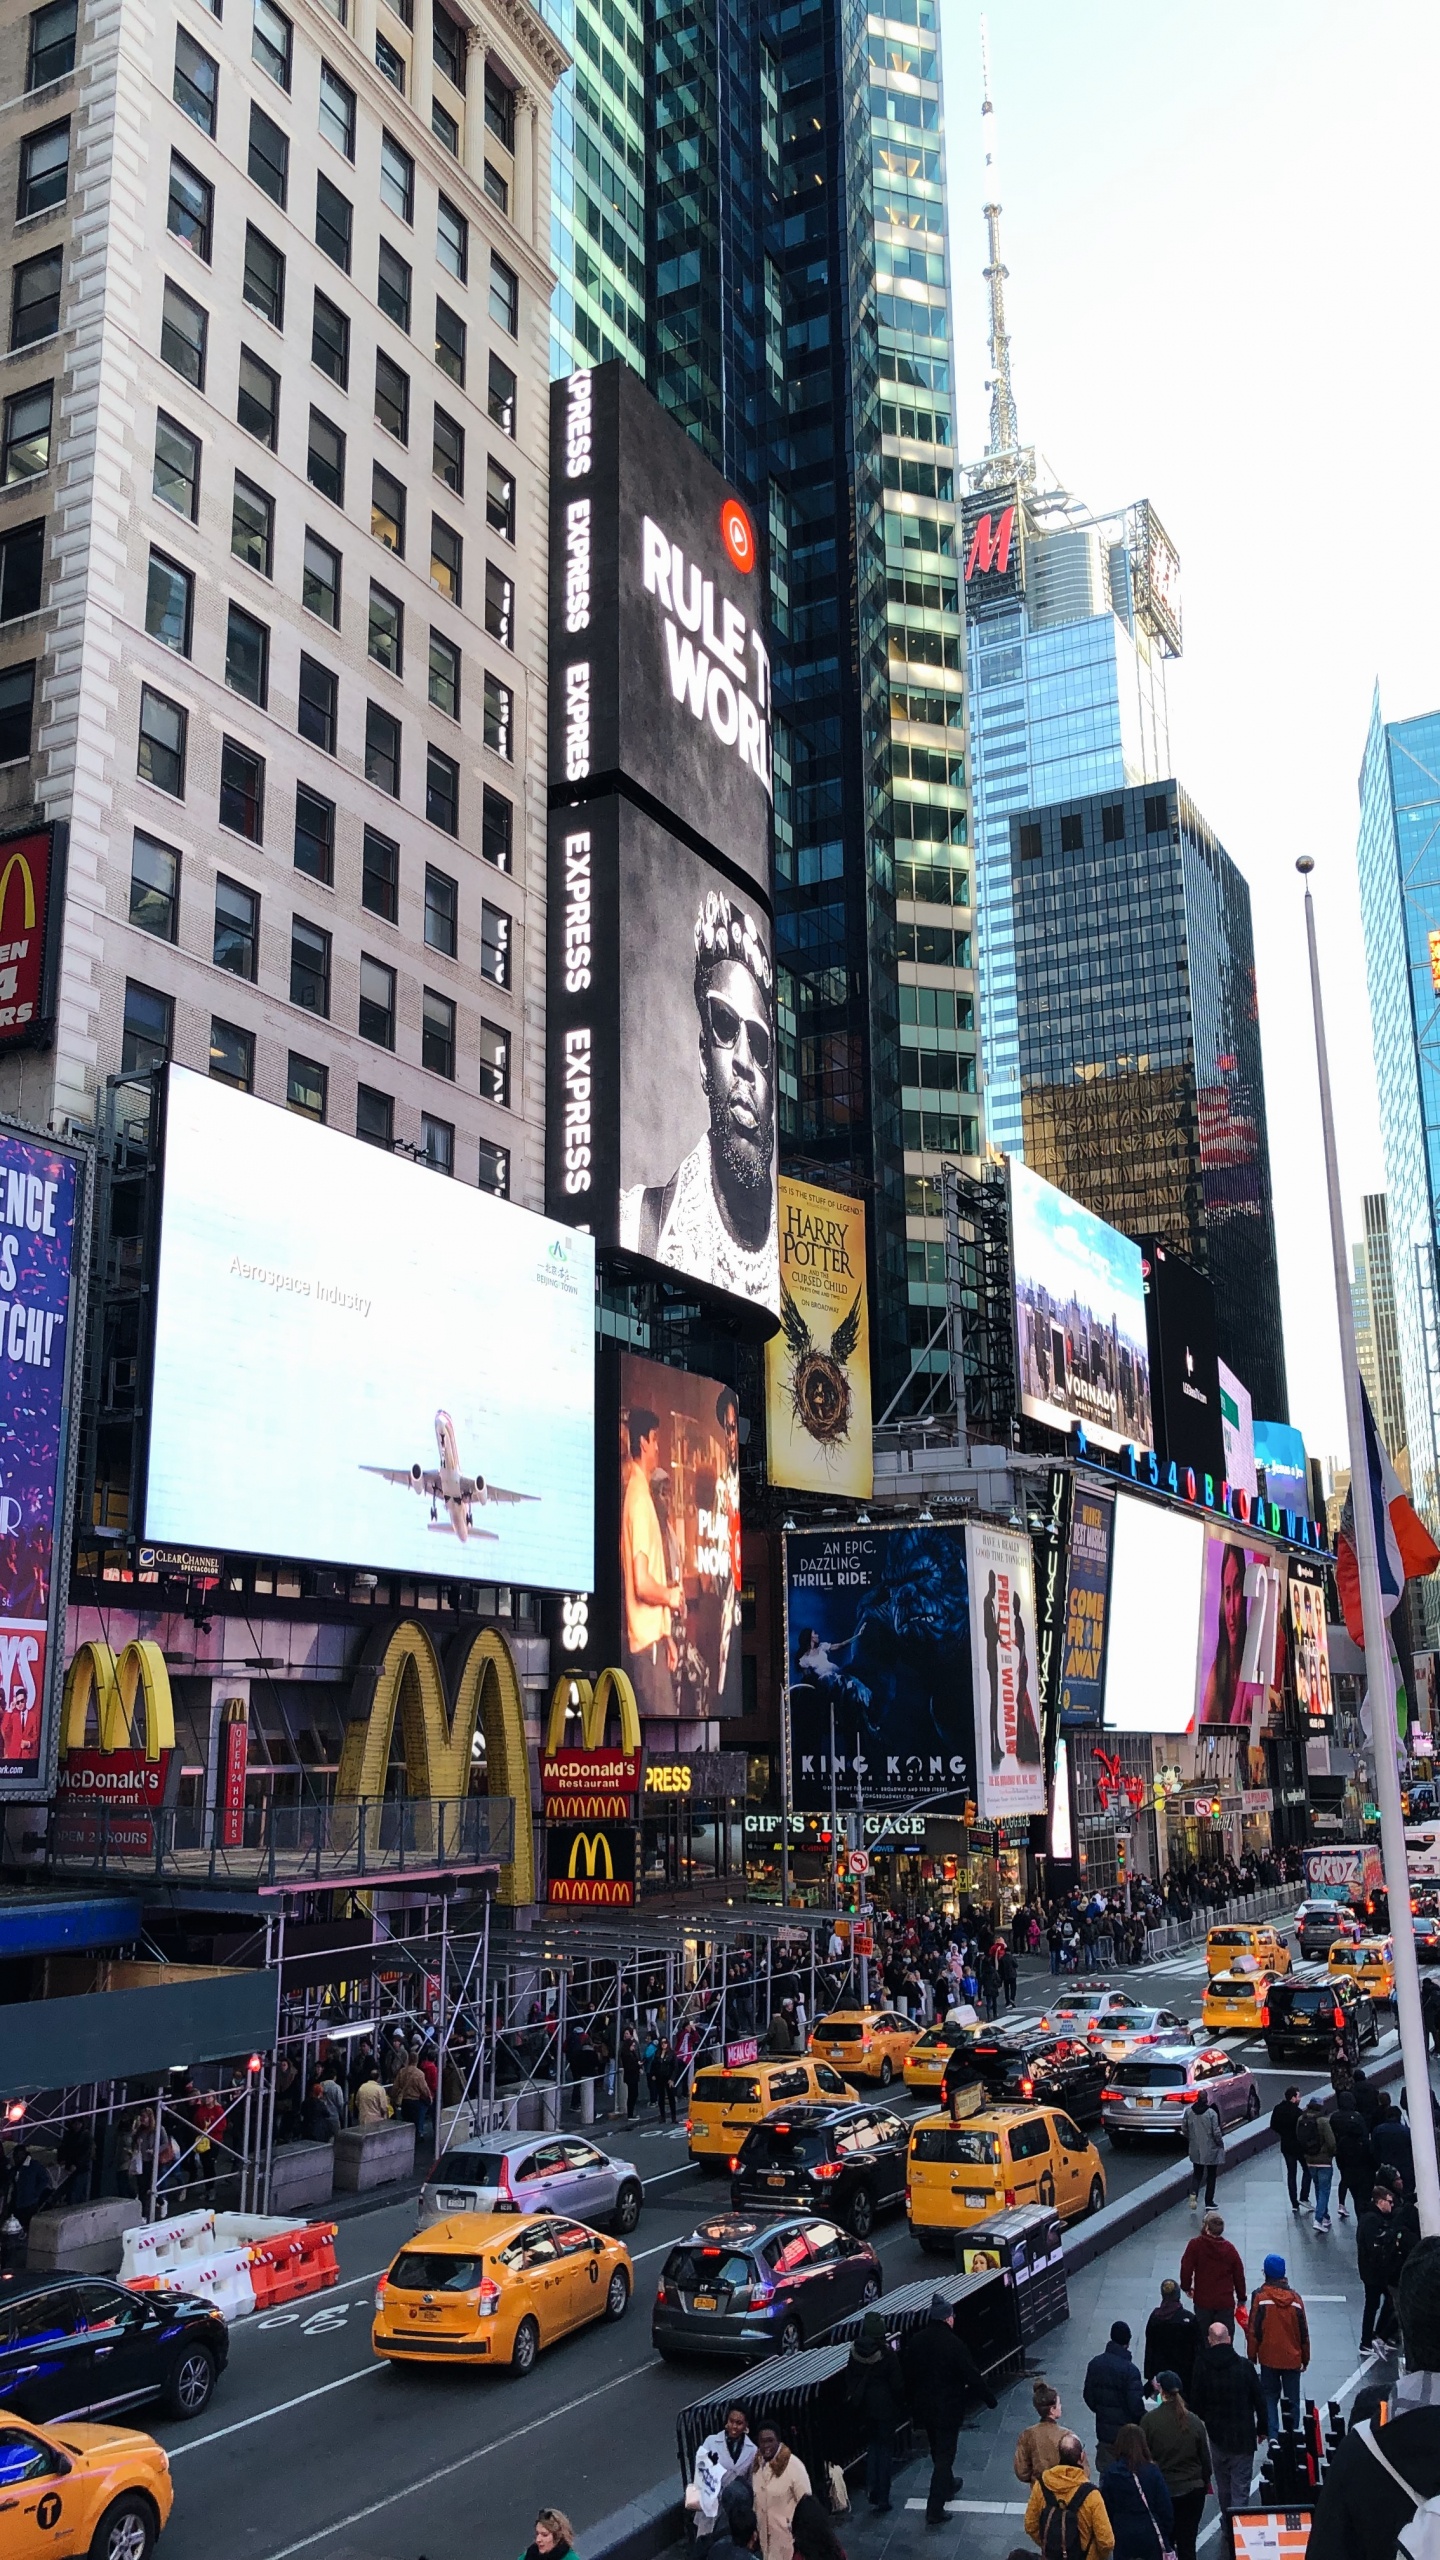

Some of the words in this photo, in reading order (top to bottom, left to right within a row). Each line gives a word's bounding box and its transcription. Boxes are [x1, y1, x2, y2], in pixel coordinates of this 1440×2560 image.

[567, 499, 591, 632] EXPRESS
[643, 514, 747, 684] RULE
[665, 617, 772, 799] WORL
[565, 832, 591, 993] EXPRESS
[565, 1028, 591, 1195] EXPRESS
[795, 1189, 808, 1201] THE
[808, 1193, 826, 1206] STUFF
[827, 1200, 836, 1208] OF
[786, 1204, 849, 1251] HARRY
[783, 1231, 855, 1279] POTTER
[536, 1273, 559, 1289] BEIJING
[560, 1282, 578, 1295] TOWN
[791, 1271, 822, 1288] CURSED
[823, 1279, 848, 1295] CHILD
[808, 1269, 820, 1277] AND
[819, 1271, 830, 1280] THE
[230, 1256, 311, 1297] Aerospace
[316, 1281, 372, 1318] Industry
[801, 1298, 810, 1307] ON
[810, 1299, 840, 1314] BROADWAY
[1064, 1371, 1117, 1414] VORNADO
[1075, 1400, 1094, 1414] REALTY
[1094, 1408, 1111, 1422] TRUST
[936, 1495, 972, 1503] LAMAR
[1204, 1473, 1321, 1549] BROADWAY
[845, 1540, 877, 1554] EPIC,
[982, 1534, 996, 1547] HAVE
[1001, 1539, 1020, 1553] REALLY
[1073, 1522, 1087, 1546] BEST
[1086, 1525, 1108, 1551] MUSICAL
[697, 1545, 730, 1578] NOW
[800, 1556, 861, 1572] DAZZLING
[975, 1547, 991, 1560] GOOD
[991, 1550, 1005, 1562] TIME
[1005, 1553, 1028, 1567] TONIGHT
[180, 1564, 219, 1574] SPECTACOLOR
[792, 1572, 834, 1587] THRILL
[1044, 1550, 1059, 1623] MAC
[997, 1574, 1012, 1653] PRETTY
[1068, 1587, 1106, 1622] COME
[1066, 1616, 1104, 1650] FROM
[1064, 1648, 1102, 1680] AWAY
[1001, 1667, 1017, 1755] WOMAN
[233, 1728, 243, 1770] OPEN
[543, 1761, 636, 1778] McDonald's
[801, 1754, 869, 1774] KING
[886, 1755, 967, 1775] KONG
[57, 1768, 160, 1789] McDonald's
[231, 1774, 242, 1783] 24
[558, 1779, 620, 1789] Restaurant
[886, 1775, 967, 1783] BROADWAY
[821, 1816, 926, 1836] LUGAGE
[801, 1843, 830, 1852] Canon
[728, 2043, 745, 2062] MEAN
